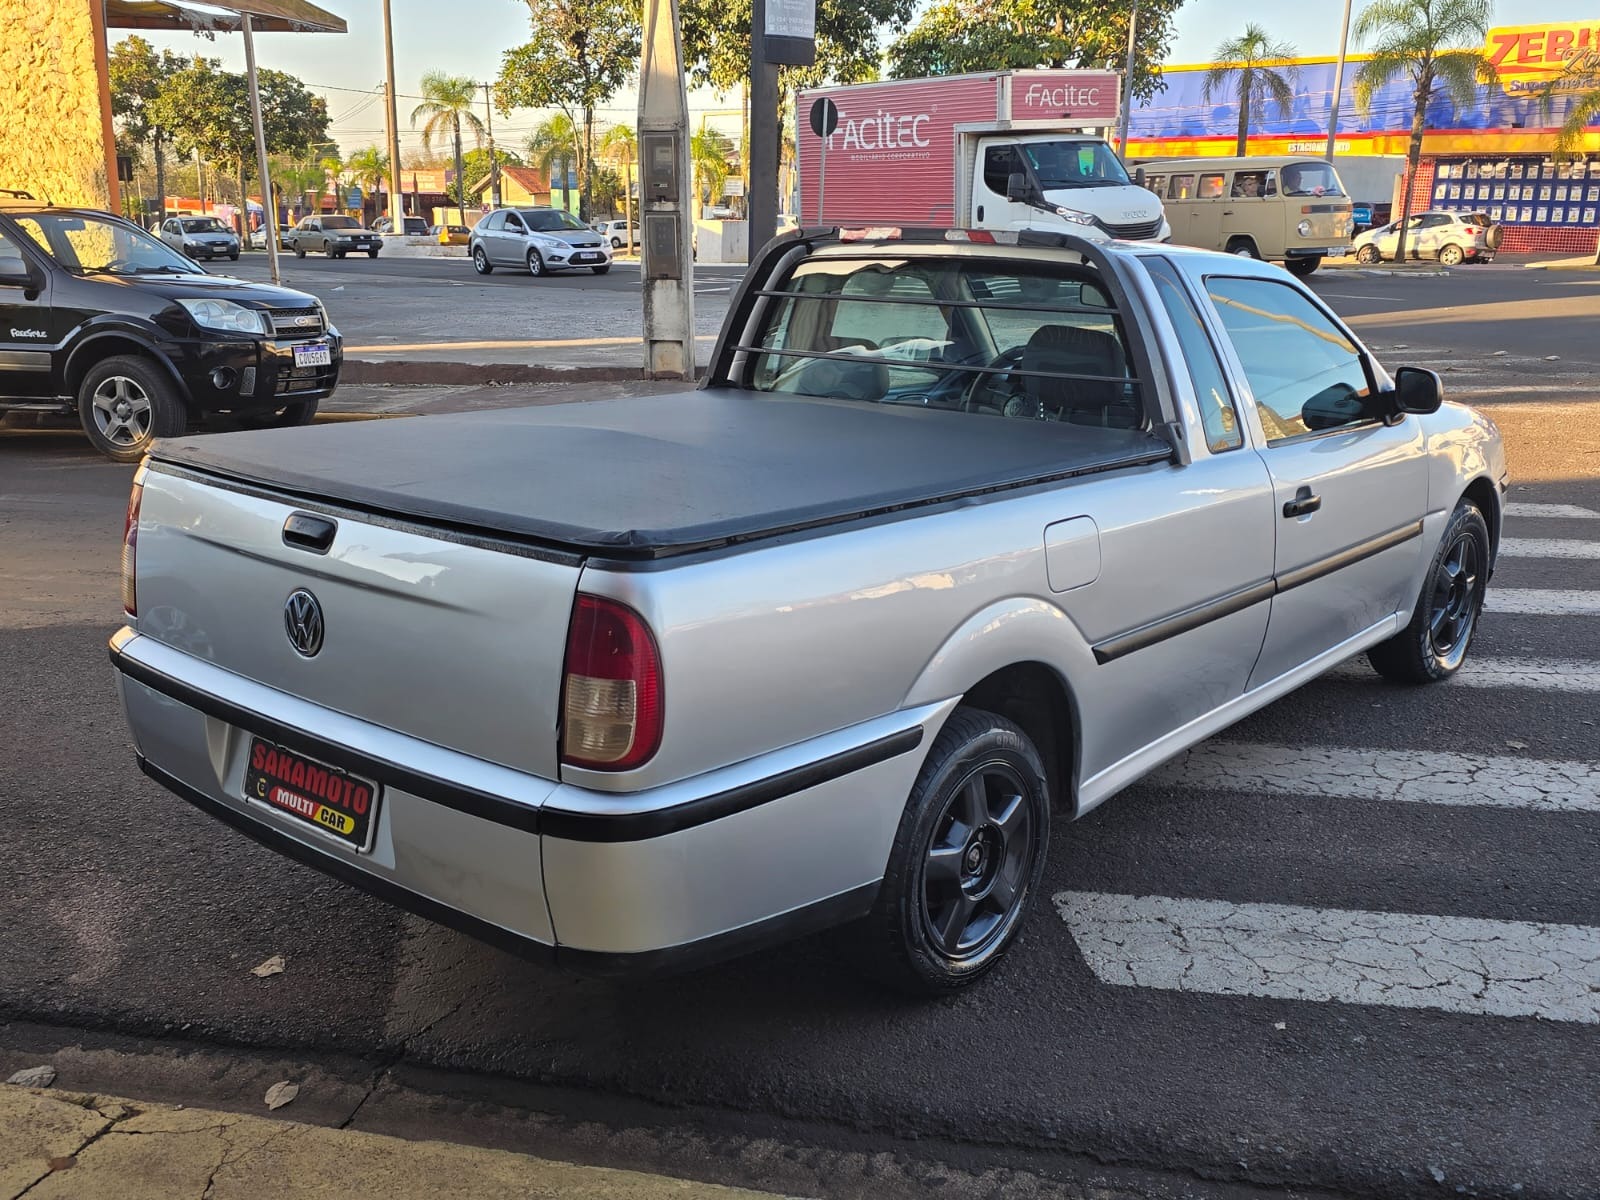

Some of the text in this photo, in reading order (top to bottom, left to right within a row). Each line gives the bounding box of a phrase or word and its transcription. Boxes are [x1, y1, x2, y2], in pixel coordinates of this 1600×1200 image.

[252, 743, 369, 816] SAKAMOTO
[276, 788, 346, 831] MULTI CAR
